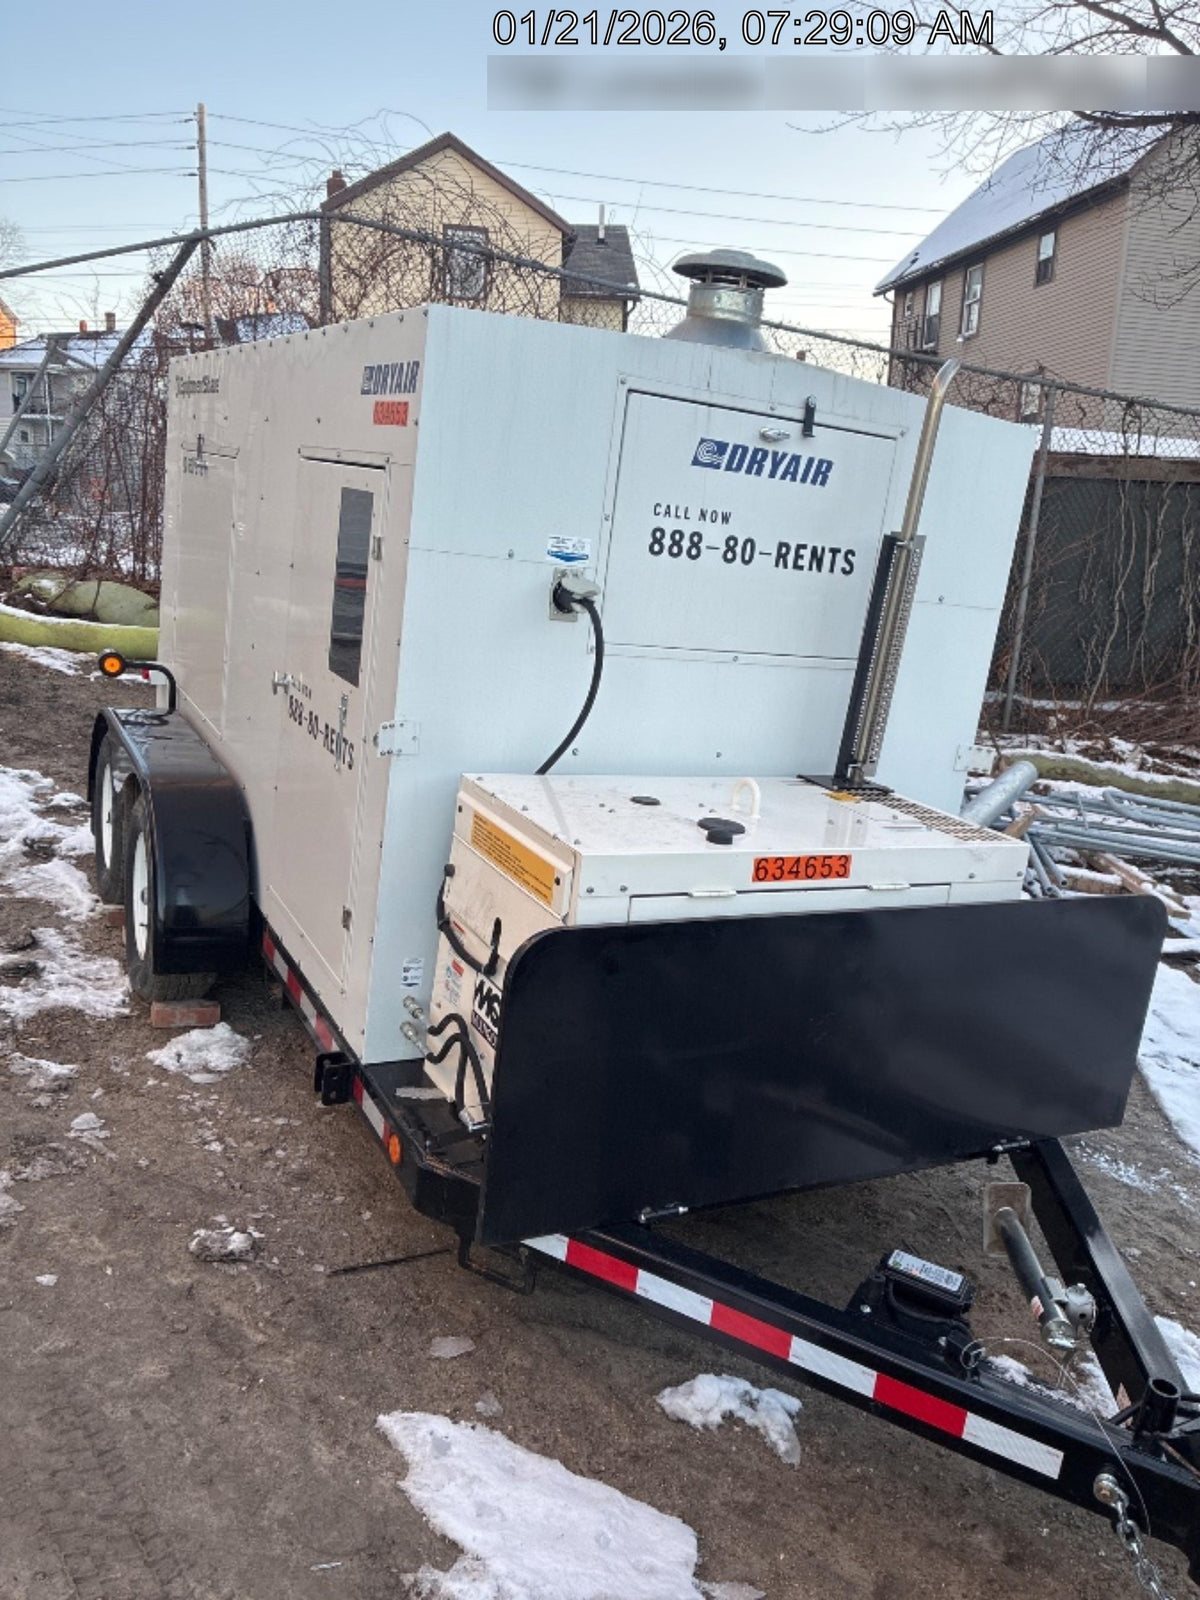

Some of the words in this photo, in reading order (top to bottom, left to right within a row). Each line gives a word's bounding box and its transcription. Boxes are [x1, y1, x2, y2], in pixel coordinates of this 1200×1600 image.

[372, 360, 420, 395] DRYAIR
[723, 443, 834, 487] DRYAIR
[653, 502, 691, 520] CALL
[698, 507, 732, 525] NOW
[648, 526, 857, 576] 888-80-RENTS
[288, 694, 354, 770] 888-80-RETS
[754, 854, 849, 881] 634653
